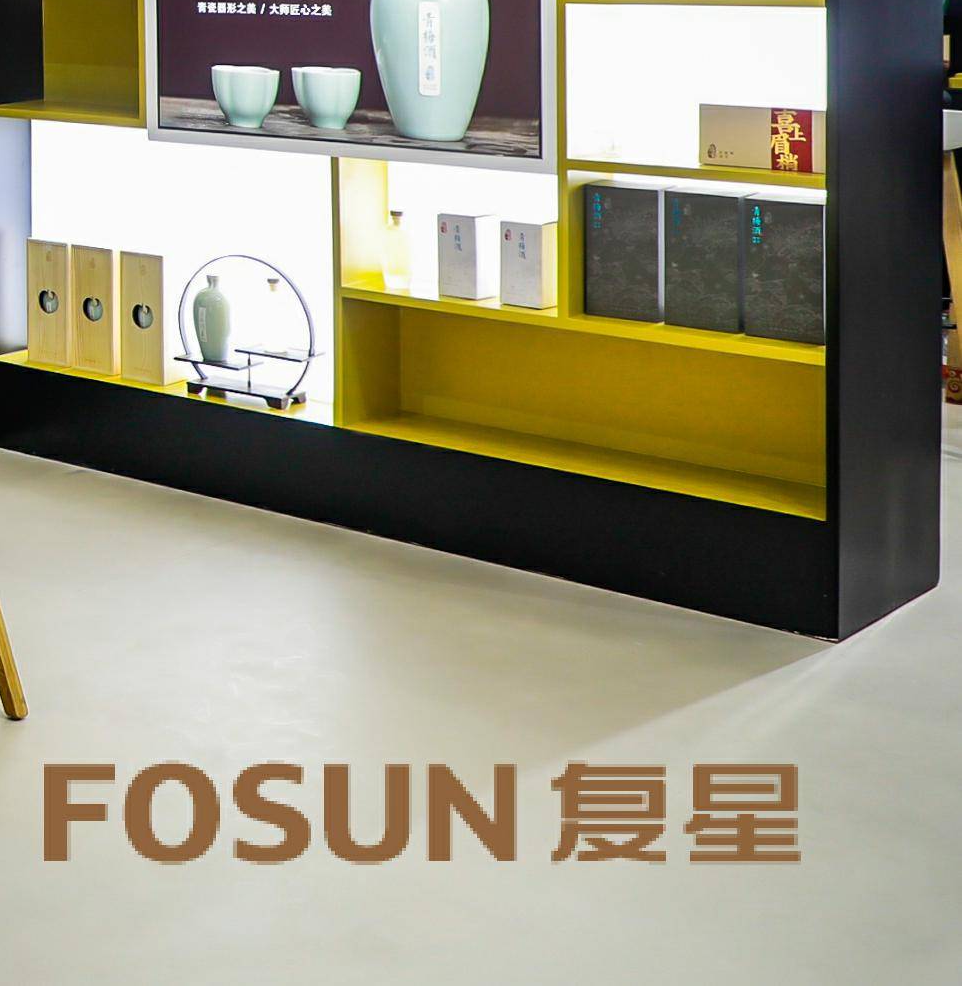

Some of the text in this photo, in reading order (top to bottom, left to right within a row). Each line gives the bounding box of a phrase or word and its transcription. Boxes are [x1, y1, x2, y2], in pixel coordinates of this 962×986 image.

[268, 3, 333, 17] 大师匠心之美
